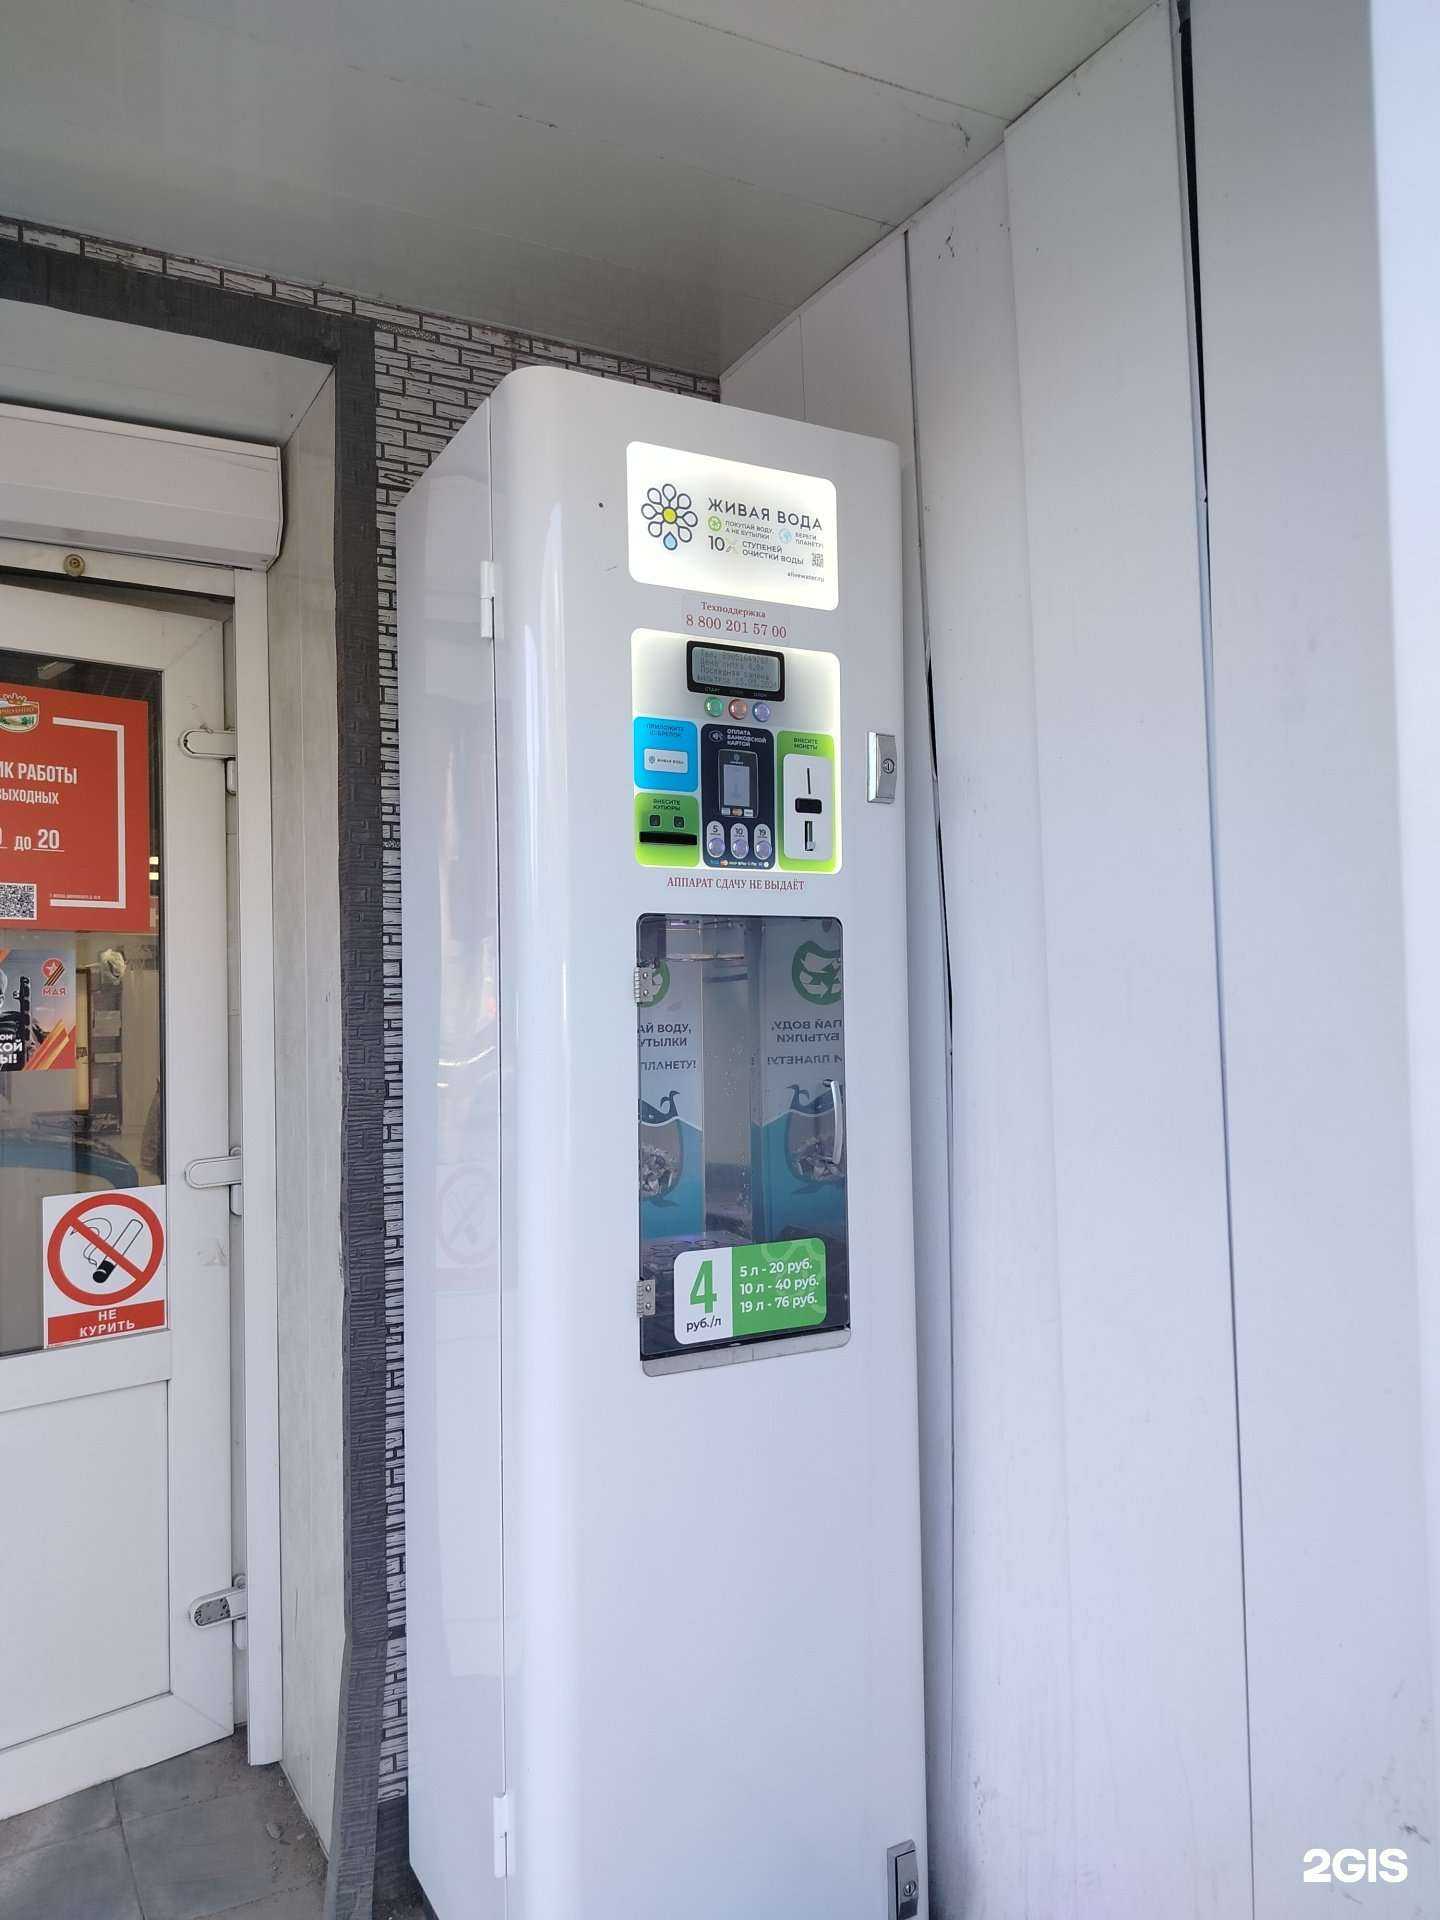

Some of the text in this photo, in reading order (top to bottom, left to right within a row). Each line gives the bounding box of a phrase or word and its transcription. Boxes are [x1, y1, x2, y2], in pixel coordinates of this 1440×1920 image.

[708, 497, 822, 531] ЖИВАЯ ВОДА
[708, 535, 725, 552] 10
[742, 540, 783, 554] СТУПЕНЕЙ
[742, 549, 804, 565] ОЧИСТКИ ВОДЫ
[700, 601, 766, 618] Техподдержка
[686, 614, 787, 639] 8 800 201 57 00
[727, 728, 751, 736] ОПЛАТА
[727, 734, 767, 744] БАНКОВСКОЙ
[727, 740, 751, 748] КАРТОЙ
[793, 737, 818, 745] ВНЕСИТЕ
[18, 763, 77, 784] РАБОТЫ
[712, 825, 719, 833] 5
[735, 827, 744, 835] 10
[14, 829, 60, 851] до 20
[667, 876, 804, 891] АППАРАТ СДАЧУ НЕ ВЫДАЁТ
[658, 1023, 691, 1035] ВОДУ,
[740, 1266, 748, 1277] 5
[750, 1267, 759, 1276] л
[769, 1262, 784, 1274] 20
[787, 1258, 812, 1274] руб.
[689, 1259, 717, 1314] 4
[740, 1283, 752, 1296] 10
[754, 1284, 764, 1293] л
[775, 1278, 791, 1291] 40
[794, 1275, 819, 1290] руб.
[740, 1301, 752, 1313] 19
[754, 1302, 764, 1312] л
[775, 1296, 789, 1309] 76
[792, 1294, 817, 1308] руб.
[98, 1309, 117, 1322] НЕ
[686, 1315, 721, 1333] руб./л
[79, 1320, 135, 1337] КУРИТЬ
